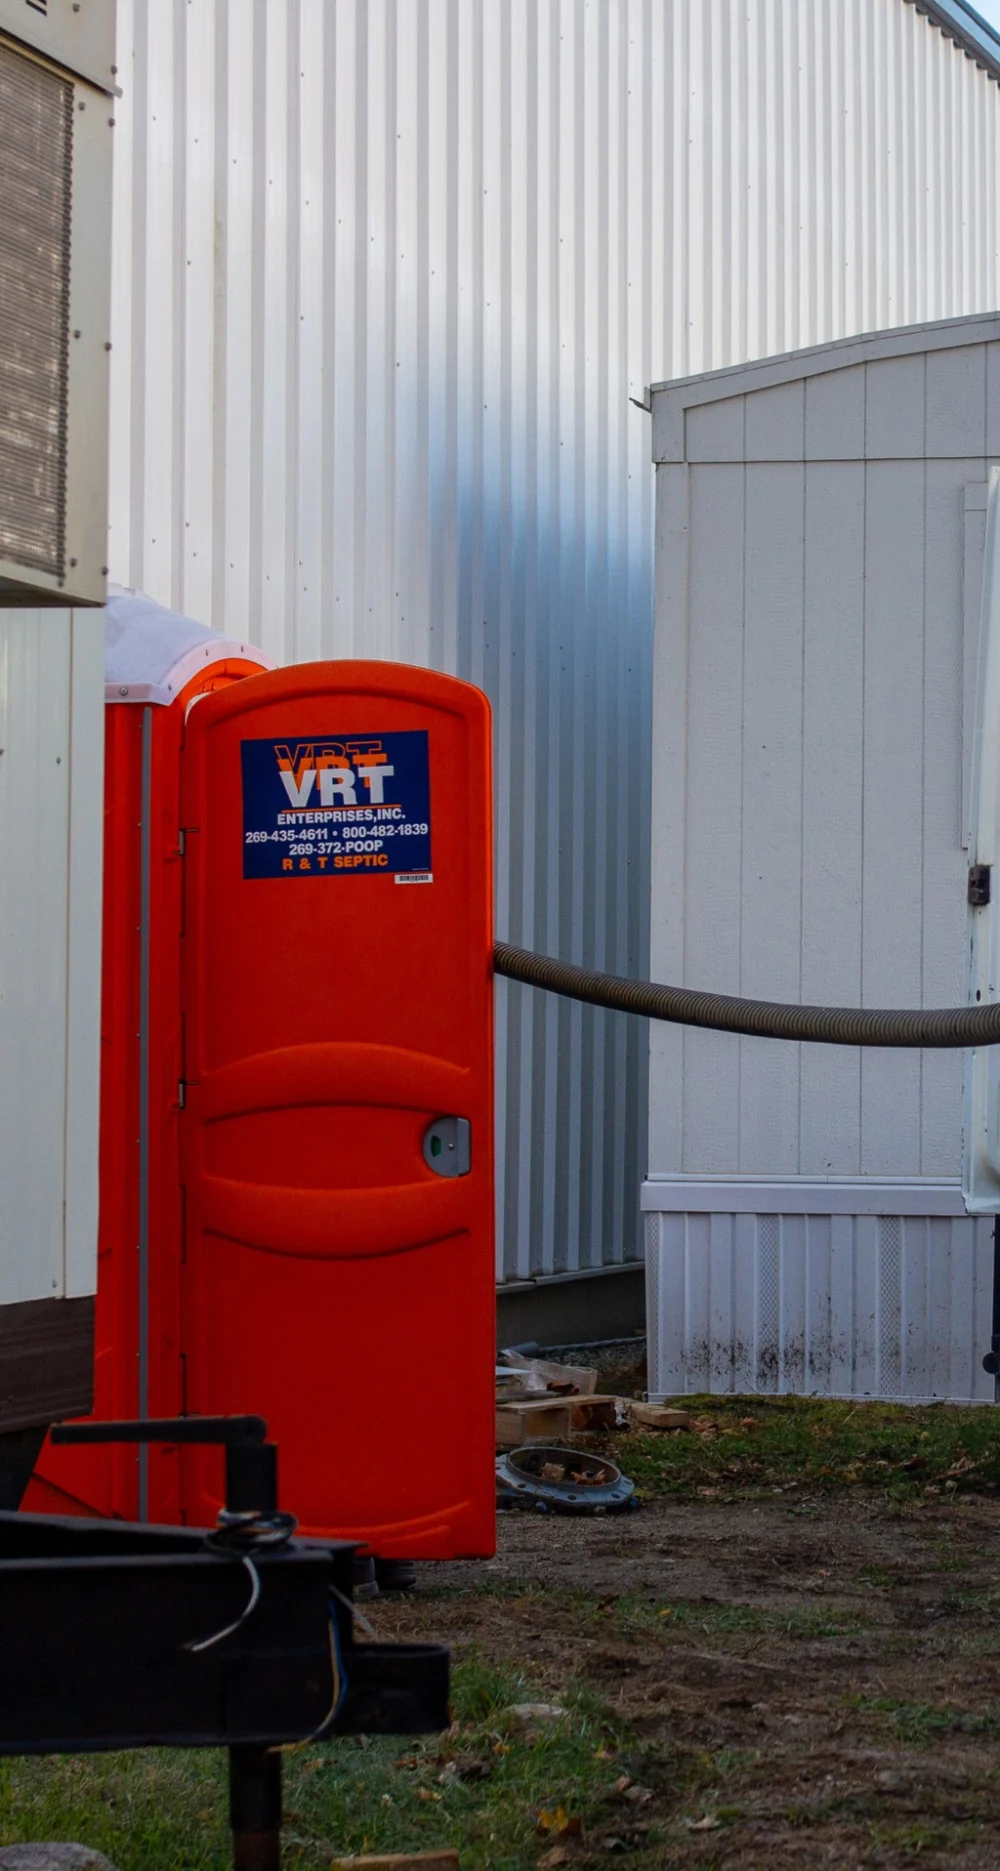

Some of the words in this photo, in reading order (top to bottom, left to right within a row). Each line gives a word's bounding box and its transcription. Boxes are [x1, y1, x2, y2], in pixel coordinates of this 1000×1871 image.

[279, 765, 394, 808] VRT
[245, 828, 328, 843] 269-435-4611
[342, 823, 429, 839] 800-482-1839
[289, 839, 383, 855] 269-372-POOP
[282, 858, 293, 870] R
[299, 858, 311, 870] &
[317, 857, 328, 868] T
[333, 854, 388, 868] SEPTIC
